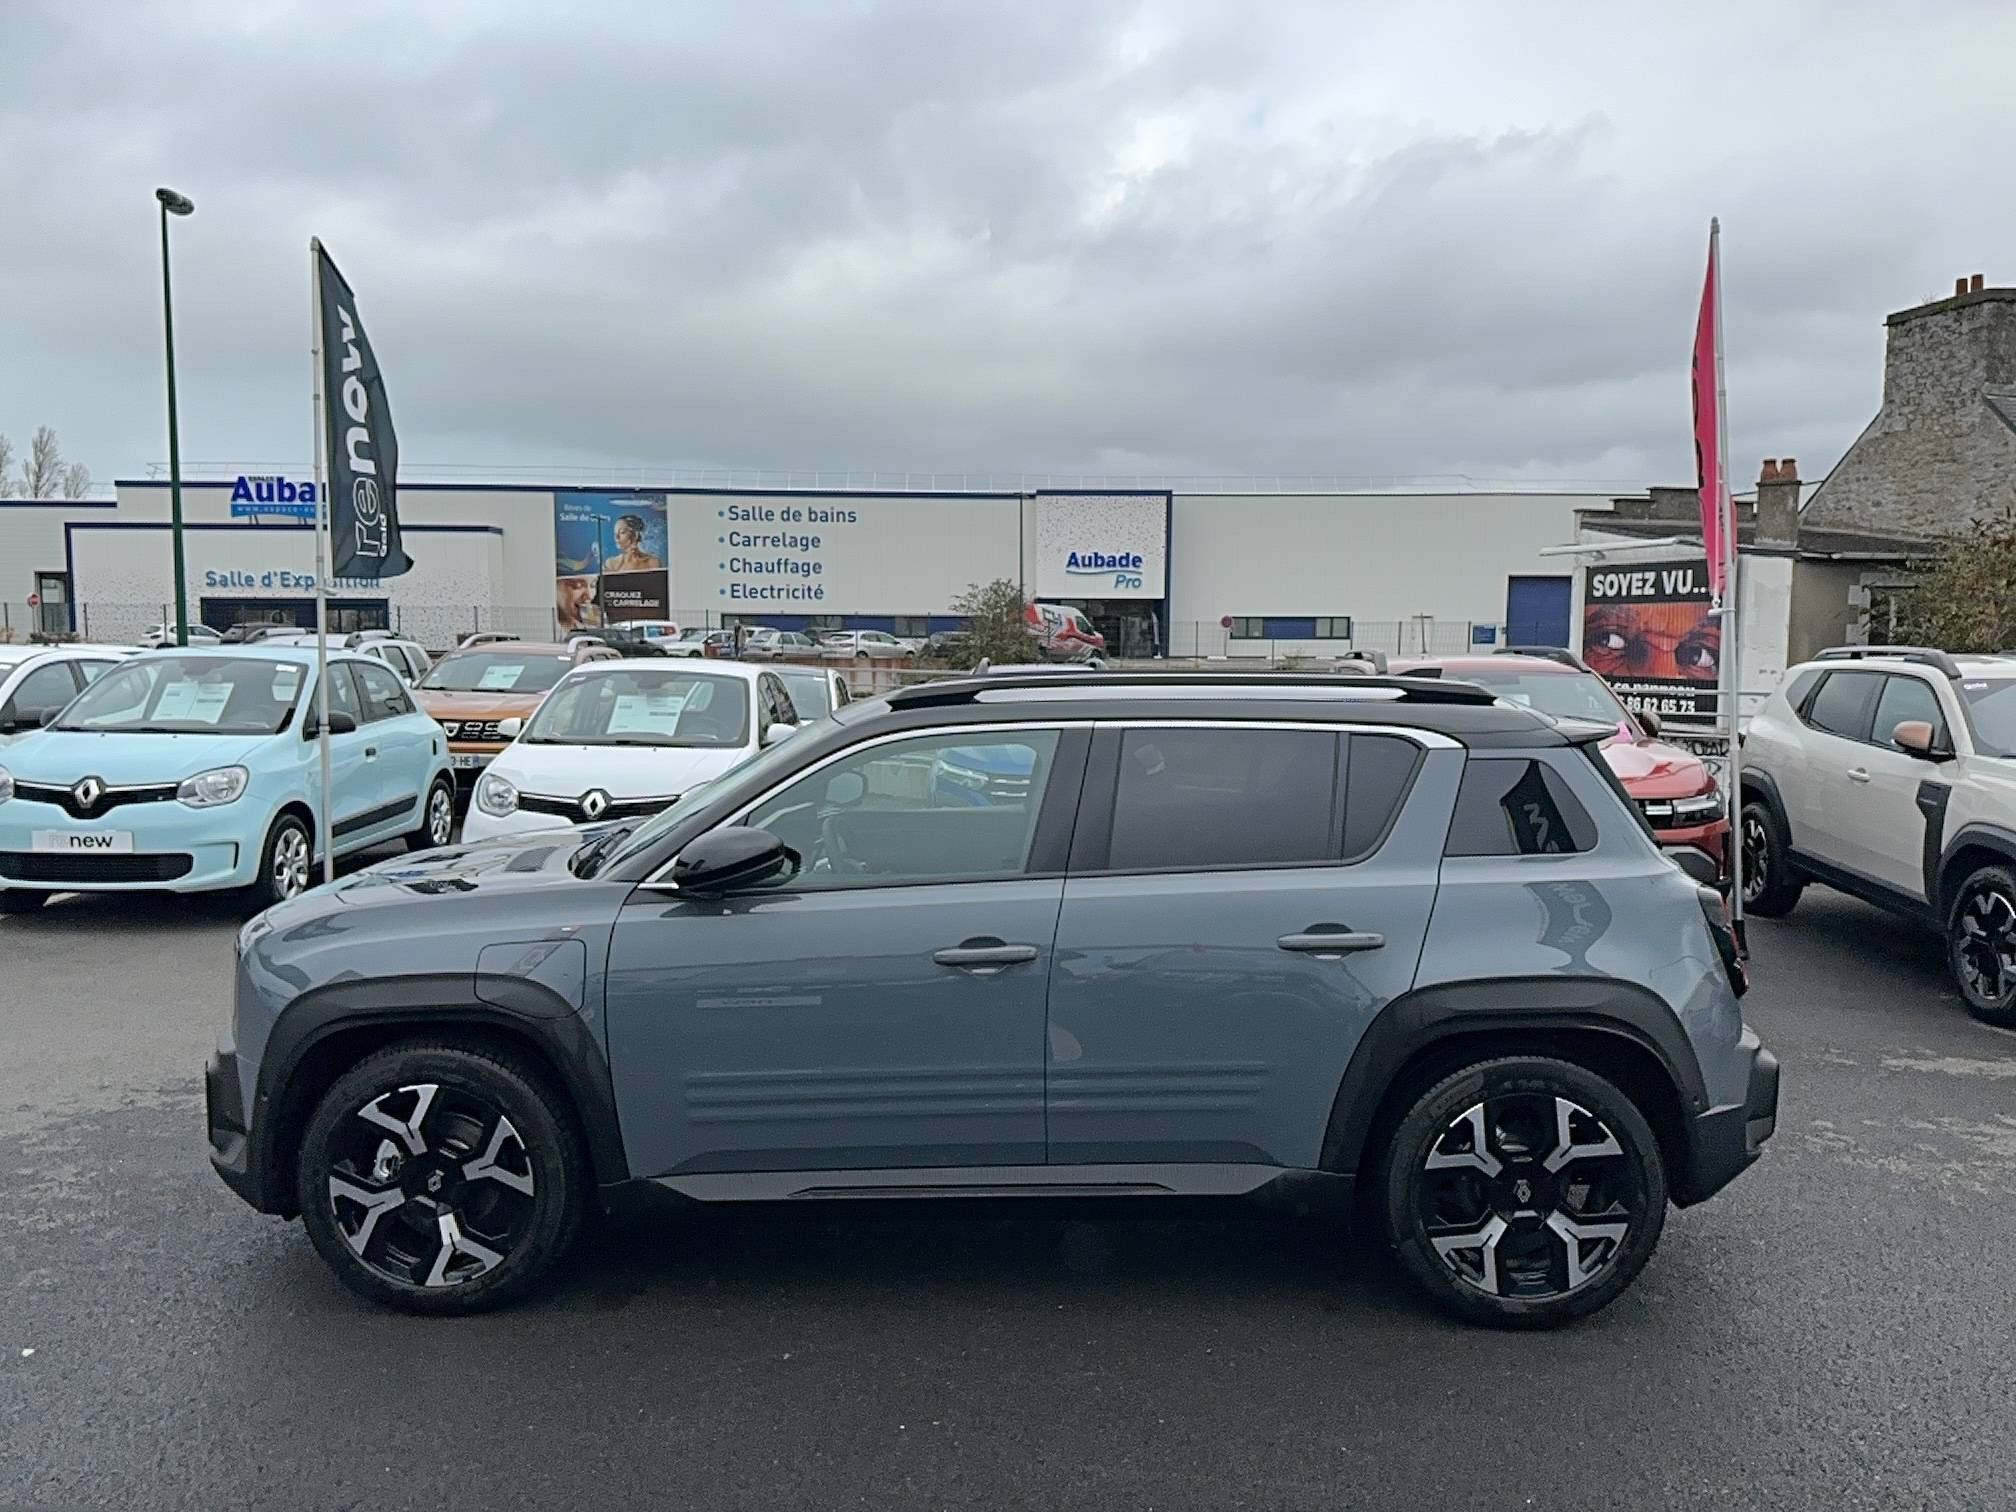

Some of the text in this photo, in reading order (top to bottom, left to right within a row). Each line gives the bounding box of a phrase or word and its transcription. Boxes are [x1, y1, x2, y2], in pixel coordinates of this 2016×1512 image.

[231, 475, 327, 503] Auba
[728, 505, 857, 523] Salle de bains
[729, 531, 821, 552] Carrelage
[729, 557, 823, 578] Chauffage
[1066, 551, 1143, 568] Aubade
[205, 570, 255, 588] Salle
[1114, 574, 1142, 589] Pro
[1592, 571, 1656, 598] SOYEZ
[730, 583, 824, 600] Electricité
[1661, 699, 1678, 713] 65
[1679, 700, 1696, 713] 73
